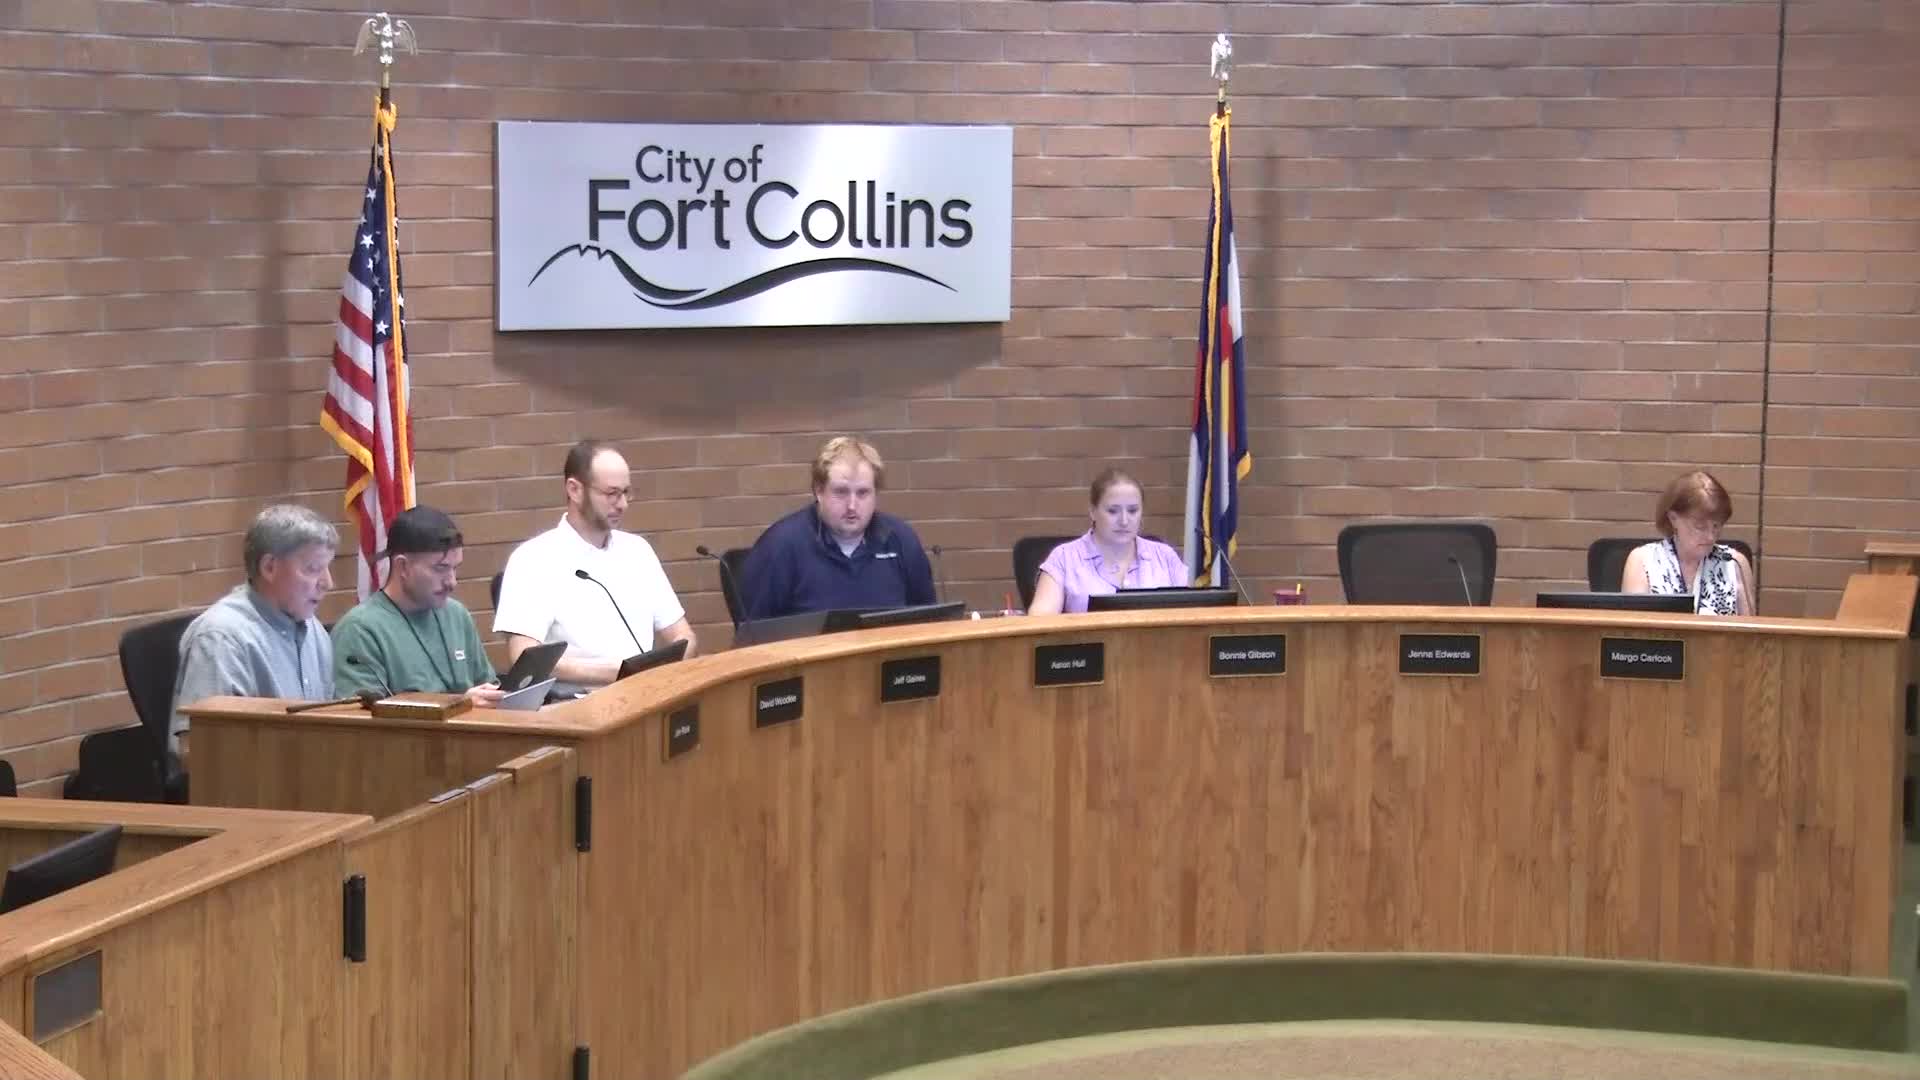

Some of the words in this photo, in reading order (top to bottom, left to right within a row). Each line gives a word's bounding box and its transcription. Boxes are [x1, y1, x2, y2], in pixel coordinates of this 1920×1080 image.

[635, 145, 715, 193] City
[724, 144, 764, 183] of
[588, 178, 731, 251] Fort
[745, 180, 974, 250] Collins
[1408, 649, 1433, 658] Jenna
[1435, 649, 1471, 659] Edwards
[1611, 652, 1639, 663] Margo
